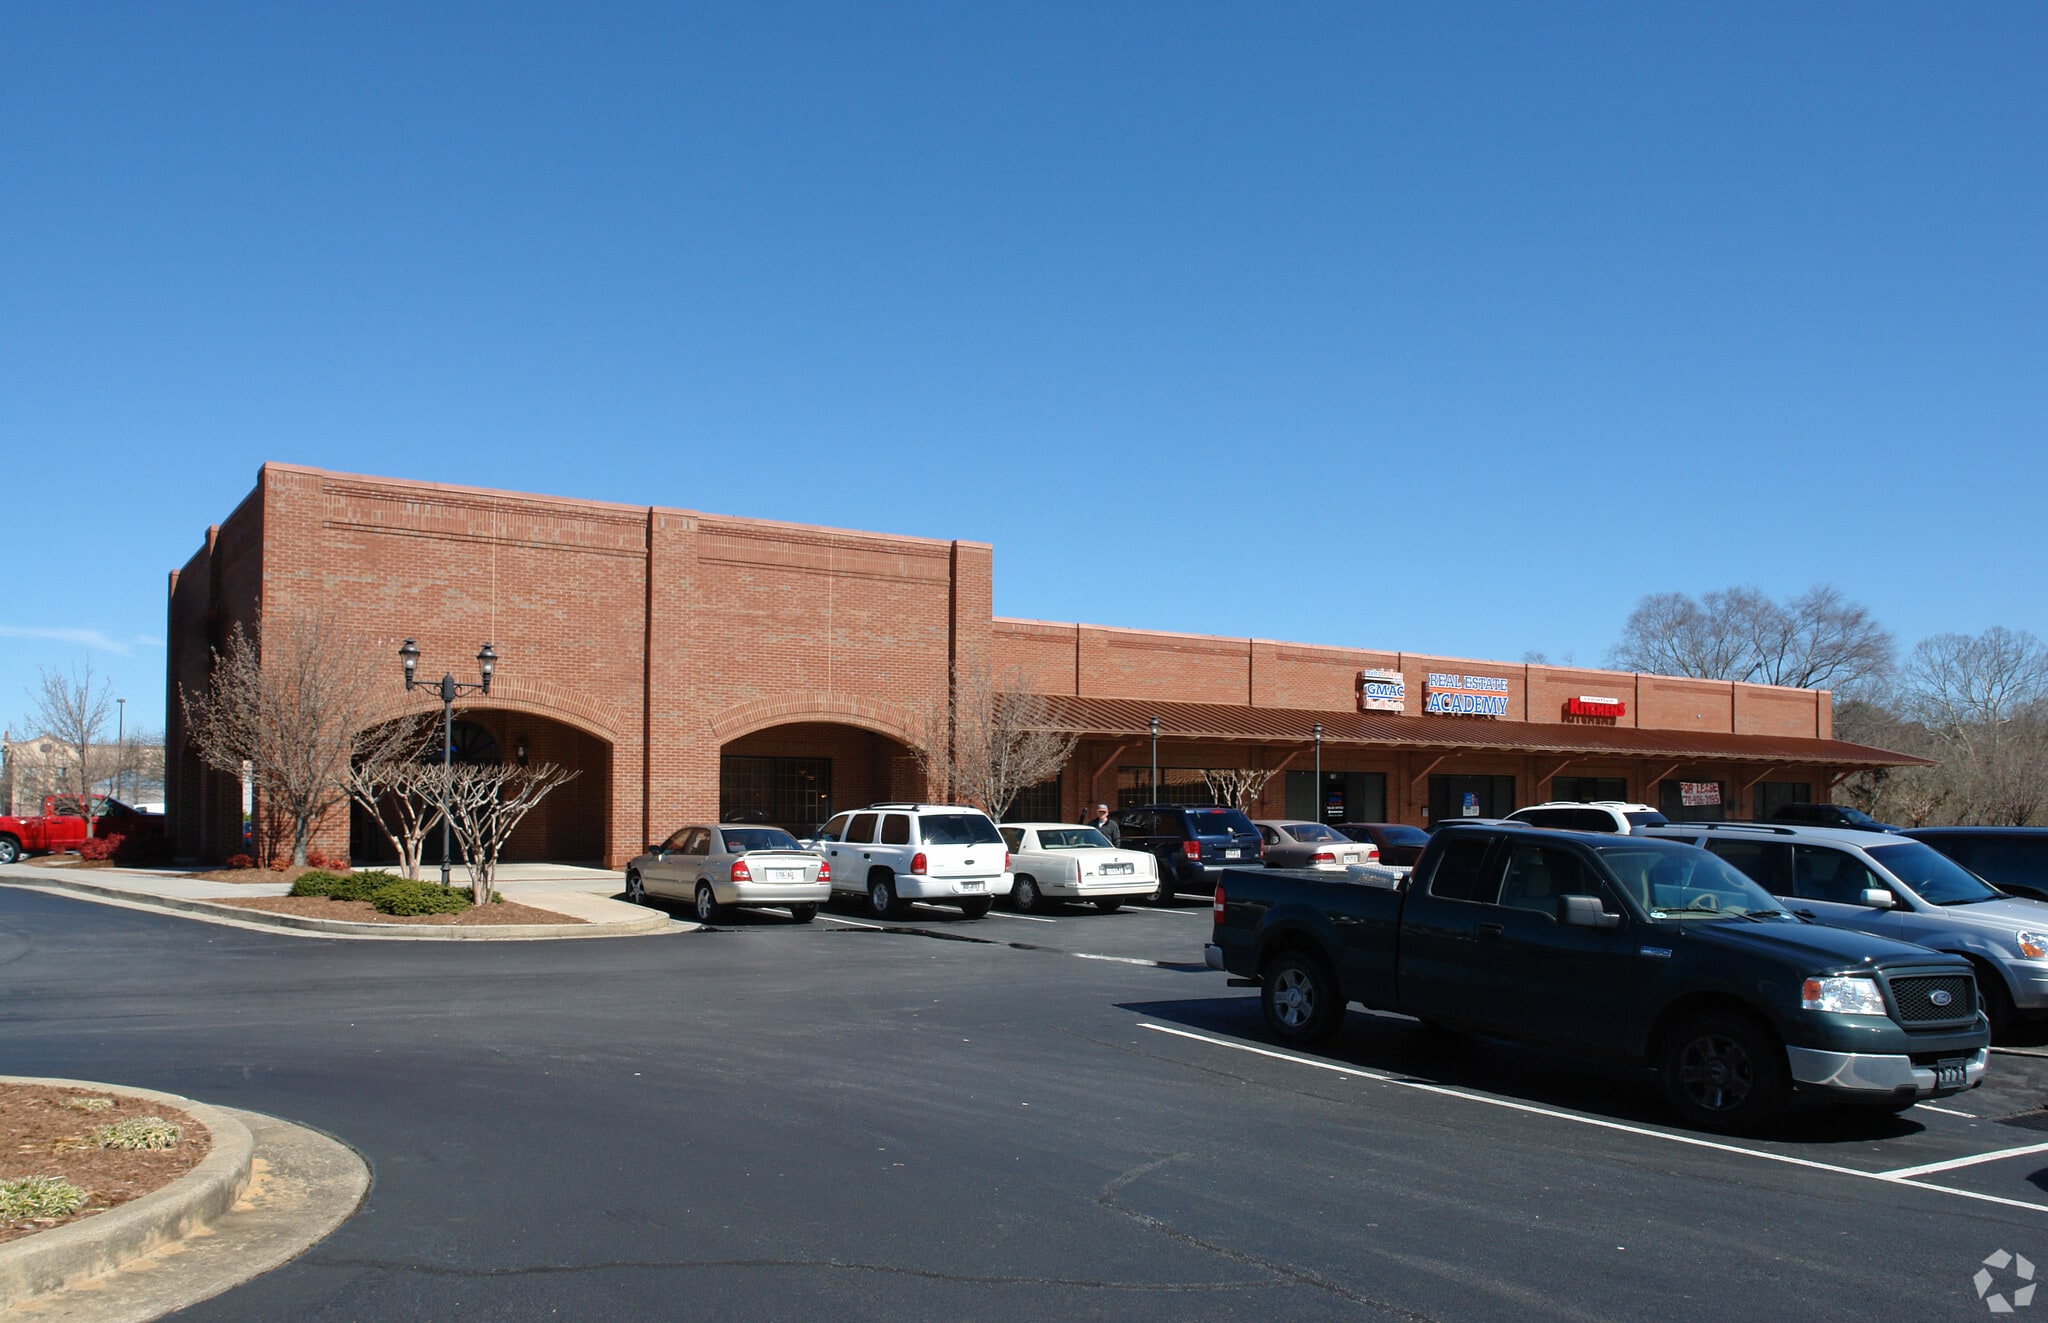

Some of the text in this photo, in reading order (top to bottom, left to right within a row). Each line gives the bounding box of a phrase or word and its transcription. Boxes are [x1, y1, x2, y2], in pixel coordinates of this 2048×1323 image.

[1367, 683, 1404, 696] GMAC
[1429, 674, 1507, 691] REAL ESTATE
[1429, 693, 1508, 715] ACADEMY
[1568, 698, 1626, 716] KITCHENS
